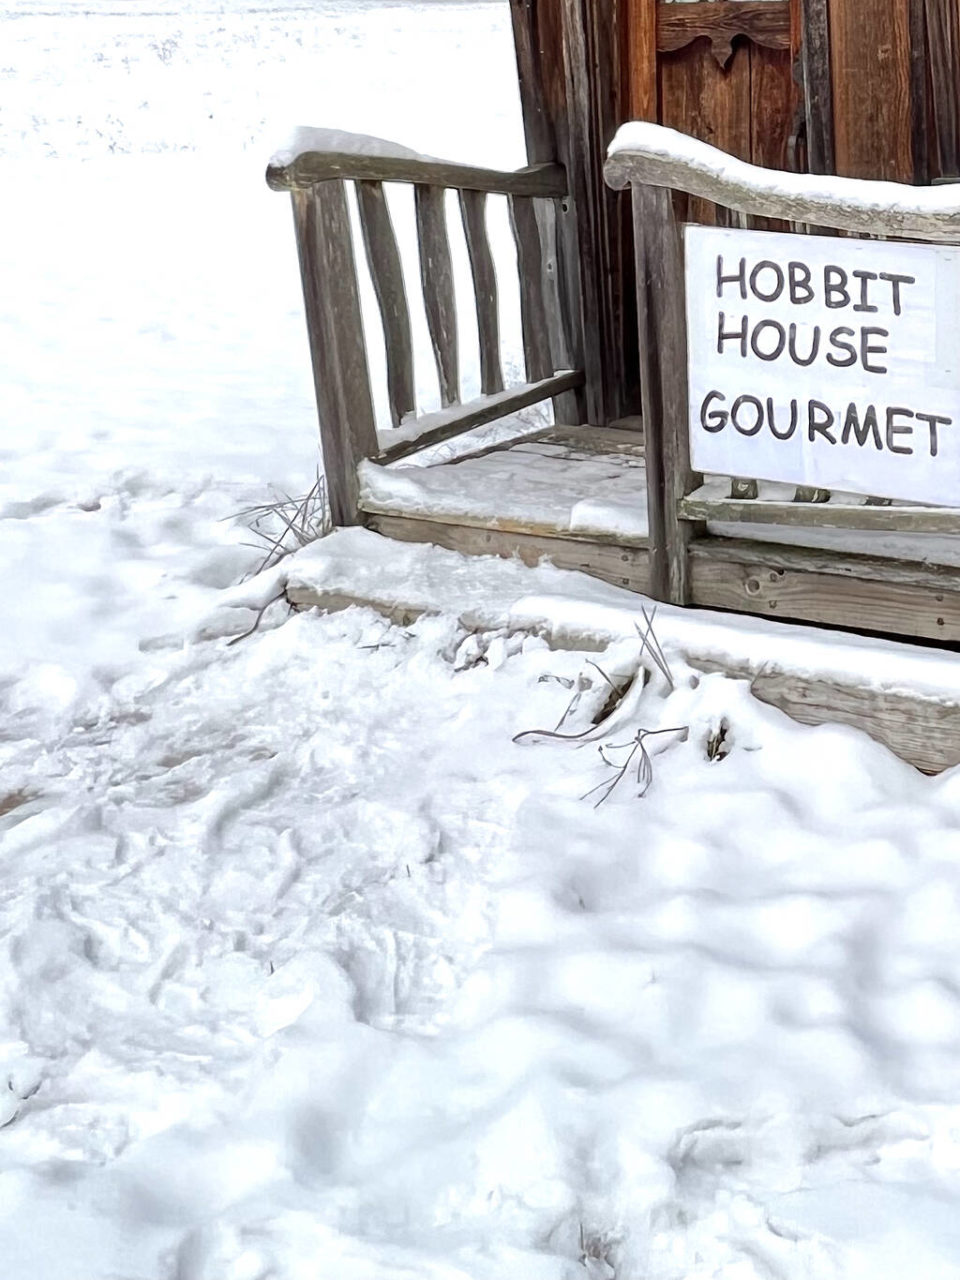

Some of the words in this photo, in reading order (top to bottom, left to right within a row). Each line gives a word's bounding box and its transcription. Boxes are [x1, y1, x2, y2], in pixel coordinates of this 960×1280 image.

[716, 254, 915, 316] HOBBIT
[717, 311, 889, 373] HOUSE
[700, 390, 952, 457] GOURMET
